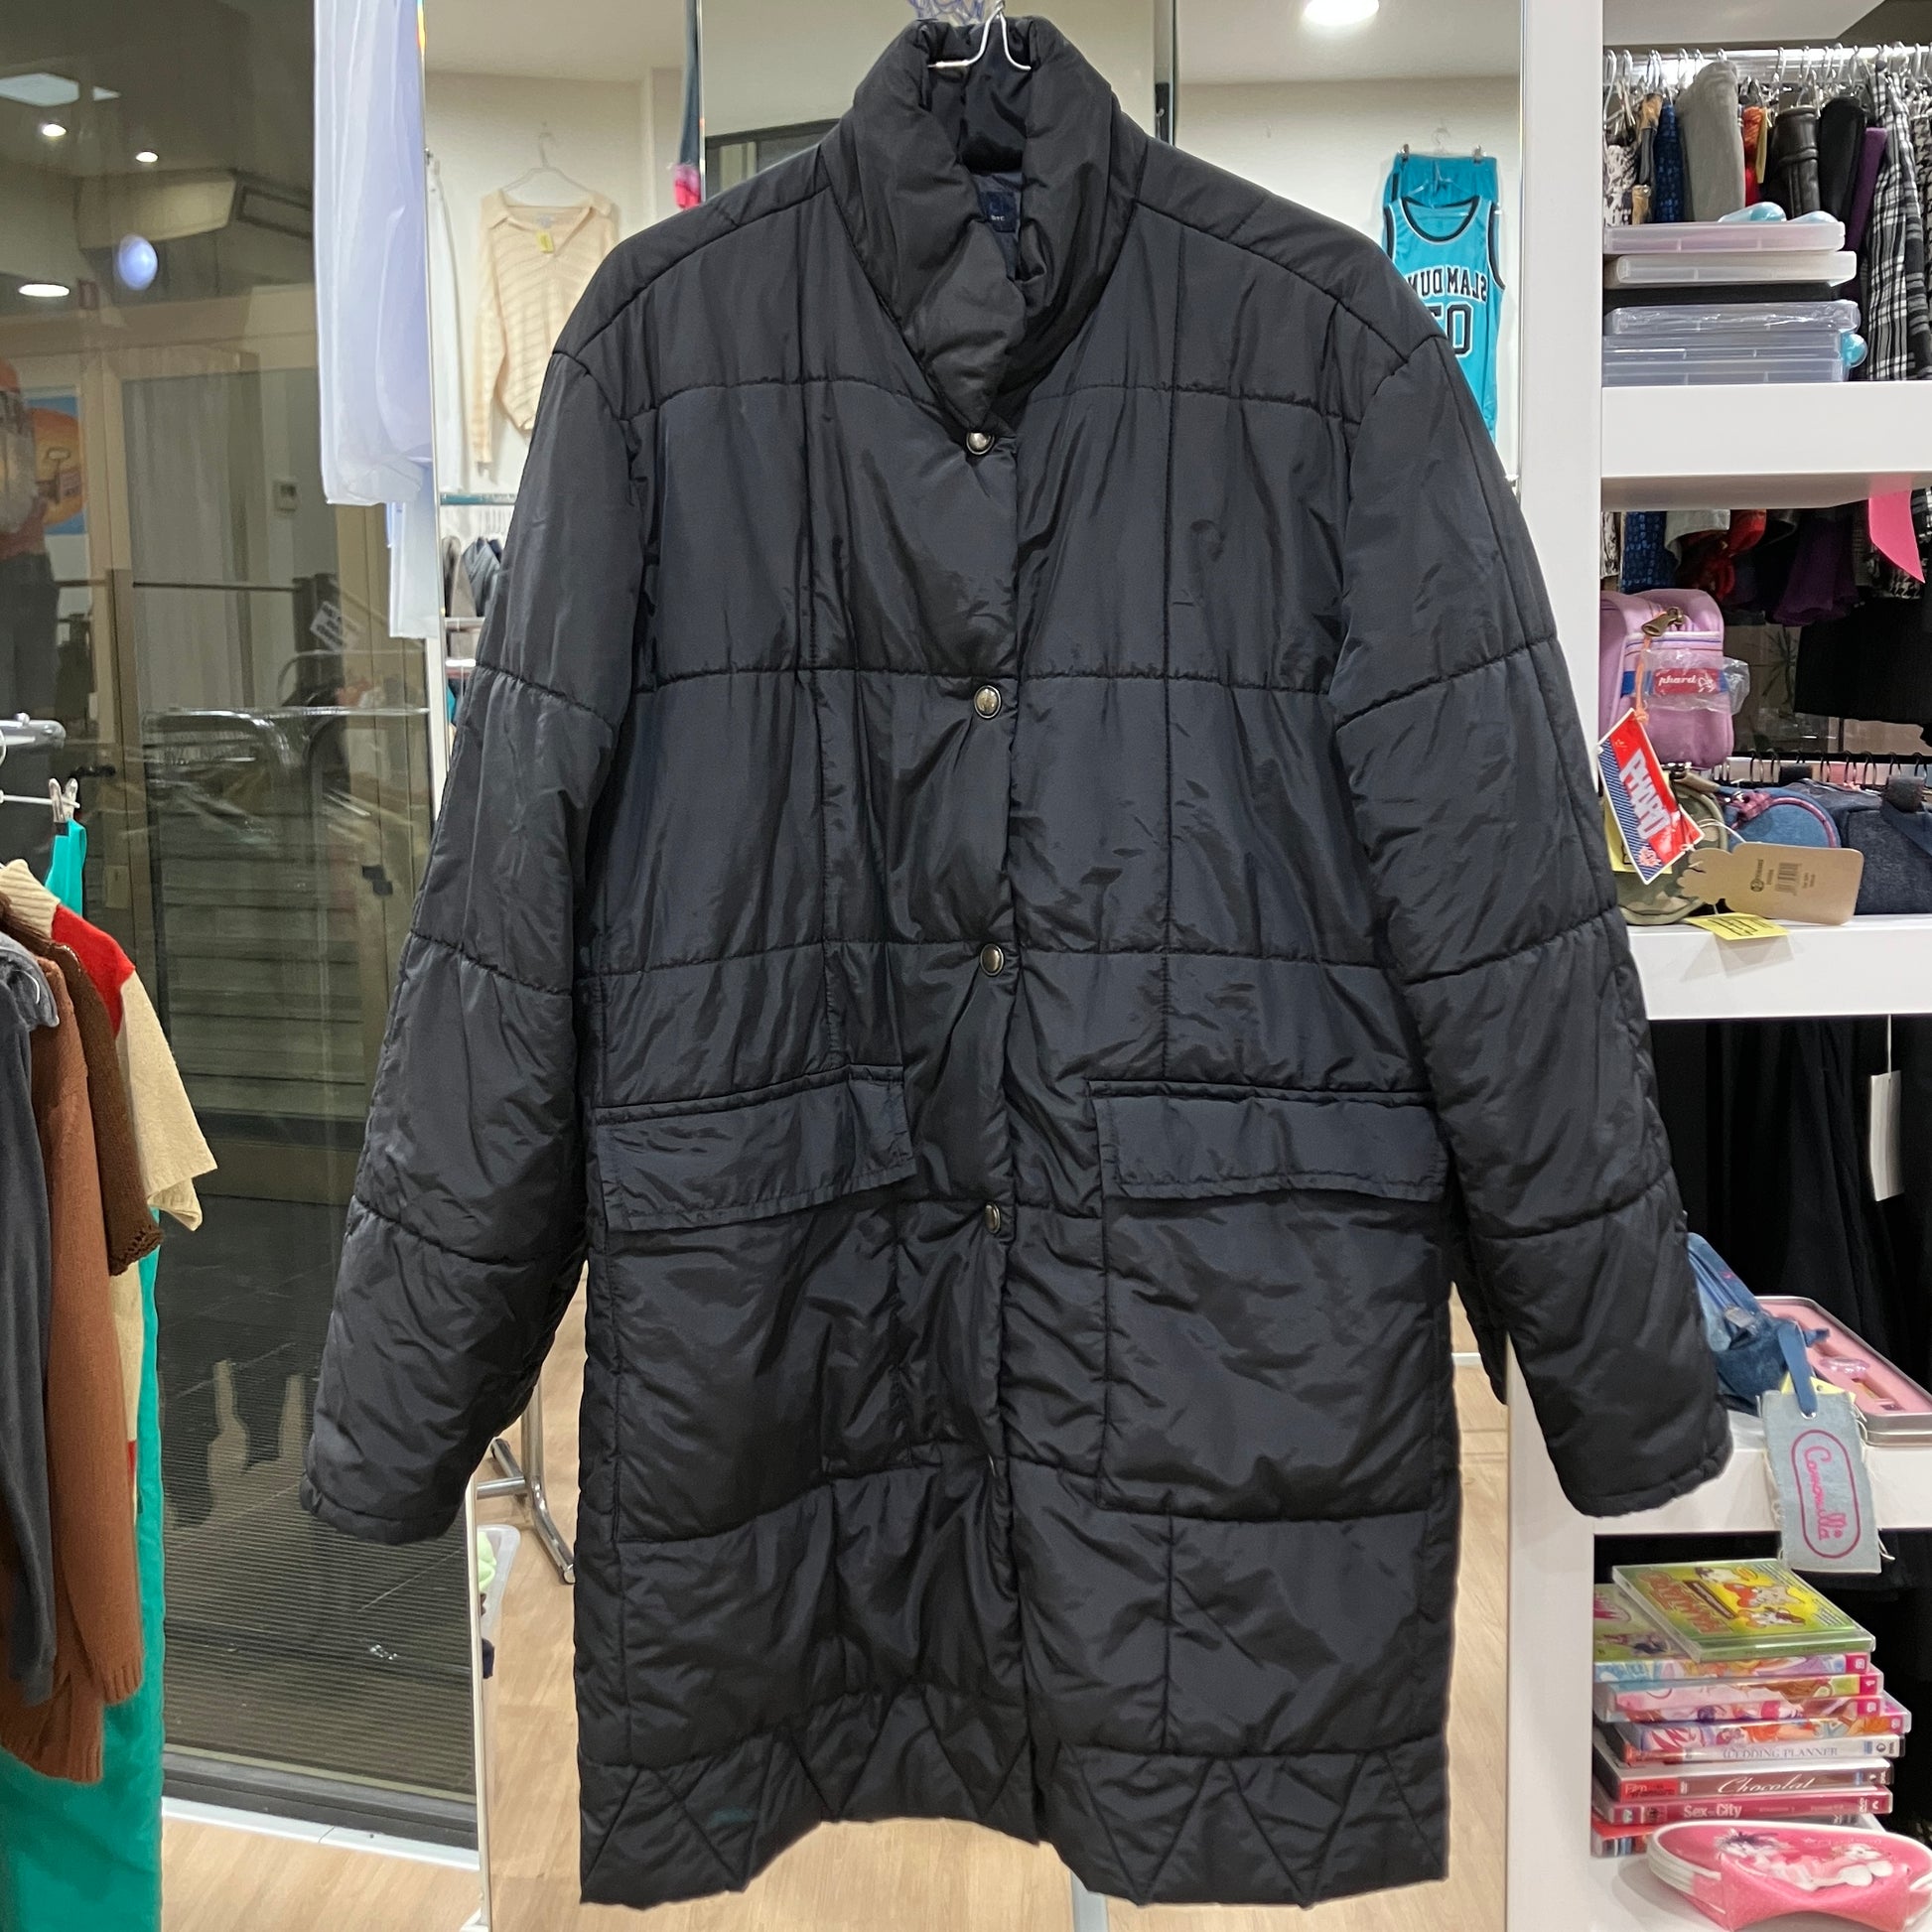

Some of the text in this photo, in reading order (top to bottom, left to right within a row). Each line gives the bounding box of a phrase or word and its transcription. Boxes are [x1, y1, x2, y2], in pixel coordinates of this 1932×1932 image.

[1658, 675, 1697, 686] phard
[1723, 1746, 1838, 1759] WEDDING PLANNER
[1718, 1773, 1816, 1793] Chocolat
[1684, 1805, 1708, 1818] Sex
[1716, 1803, 1742, 1818] City
